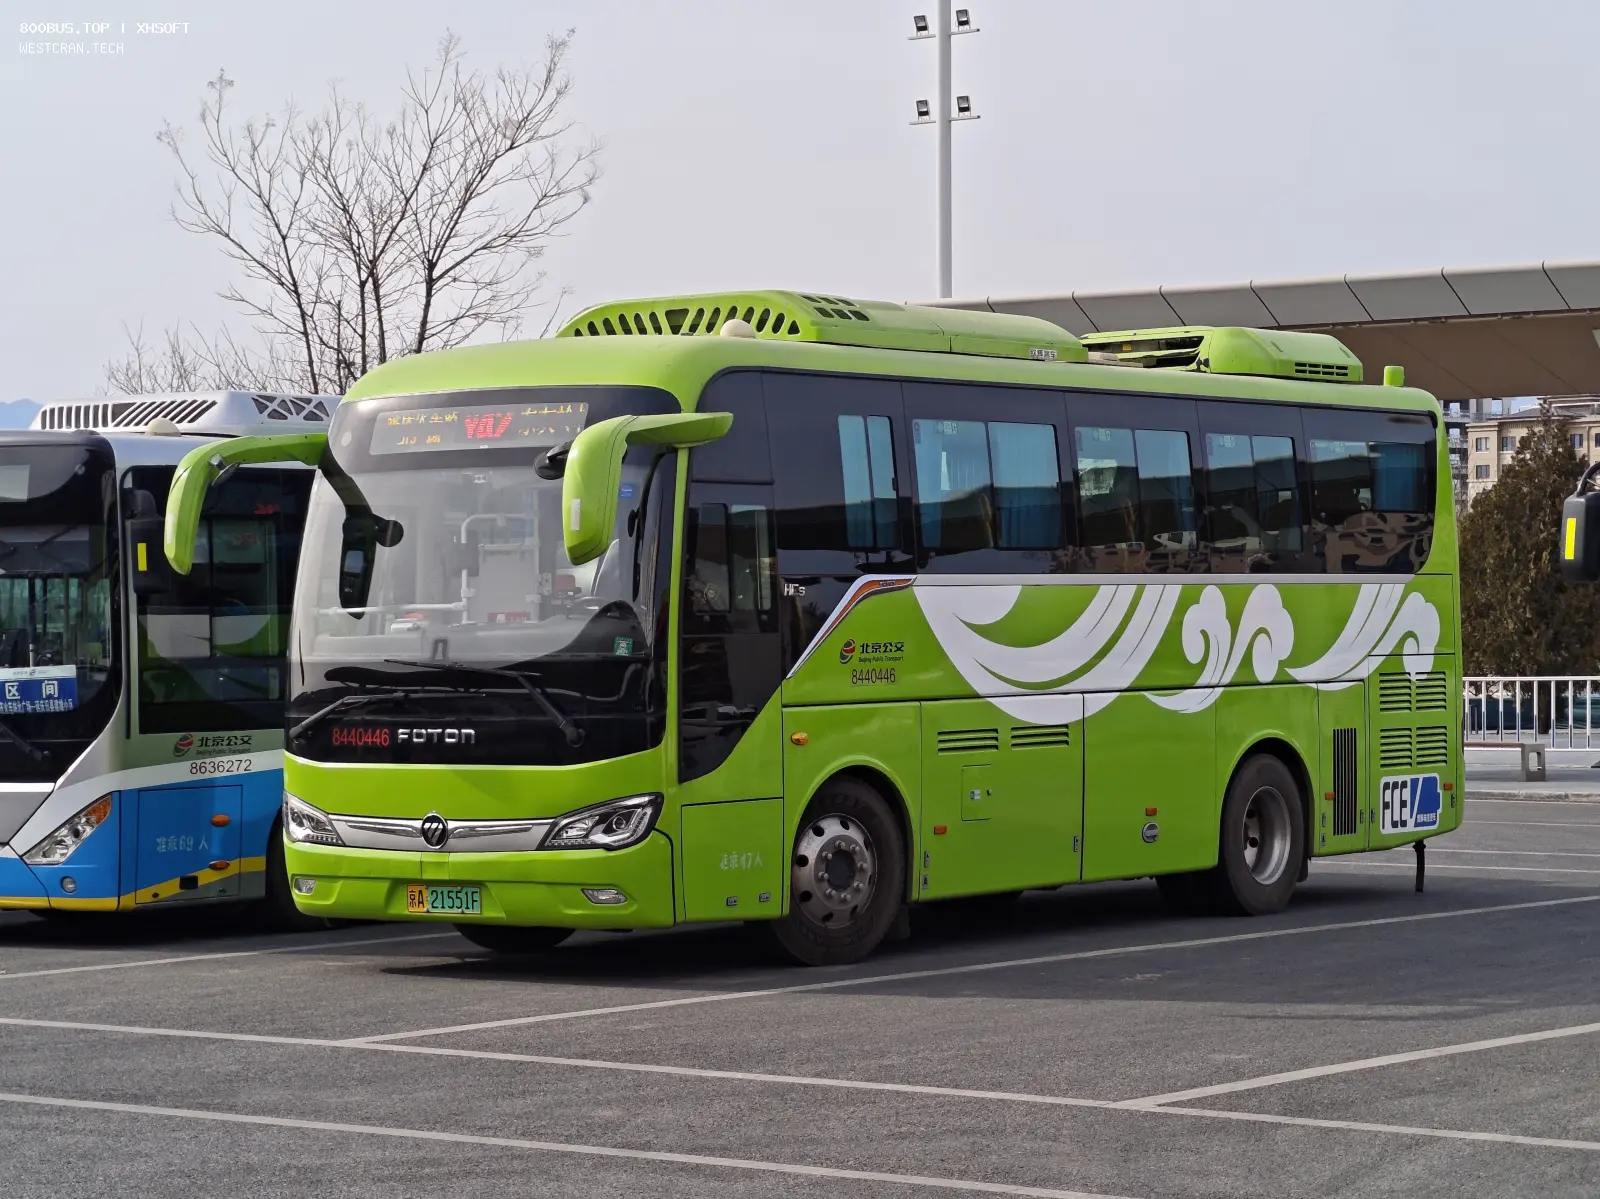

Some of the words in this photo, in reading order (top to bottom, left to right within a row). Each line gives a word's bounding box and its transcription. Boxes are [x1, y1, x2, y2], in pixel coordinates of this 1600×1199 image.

[859, 641, 905, 654] 北京公交
[851, 667, 897, 685] 8440446
[5, 682, 21, 700] 区
[42, 680, 59, 698] 间
[196, 734, 253, 748] 北京公交
[332, 728, 390, 746] 8440446
[189, 758, 252, 775] 8636272
[430, 889, 479, 910] 21551F
